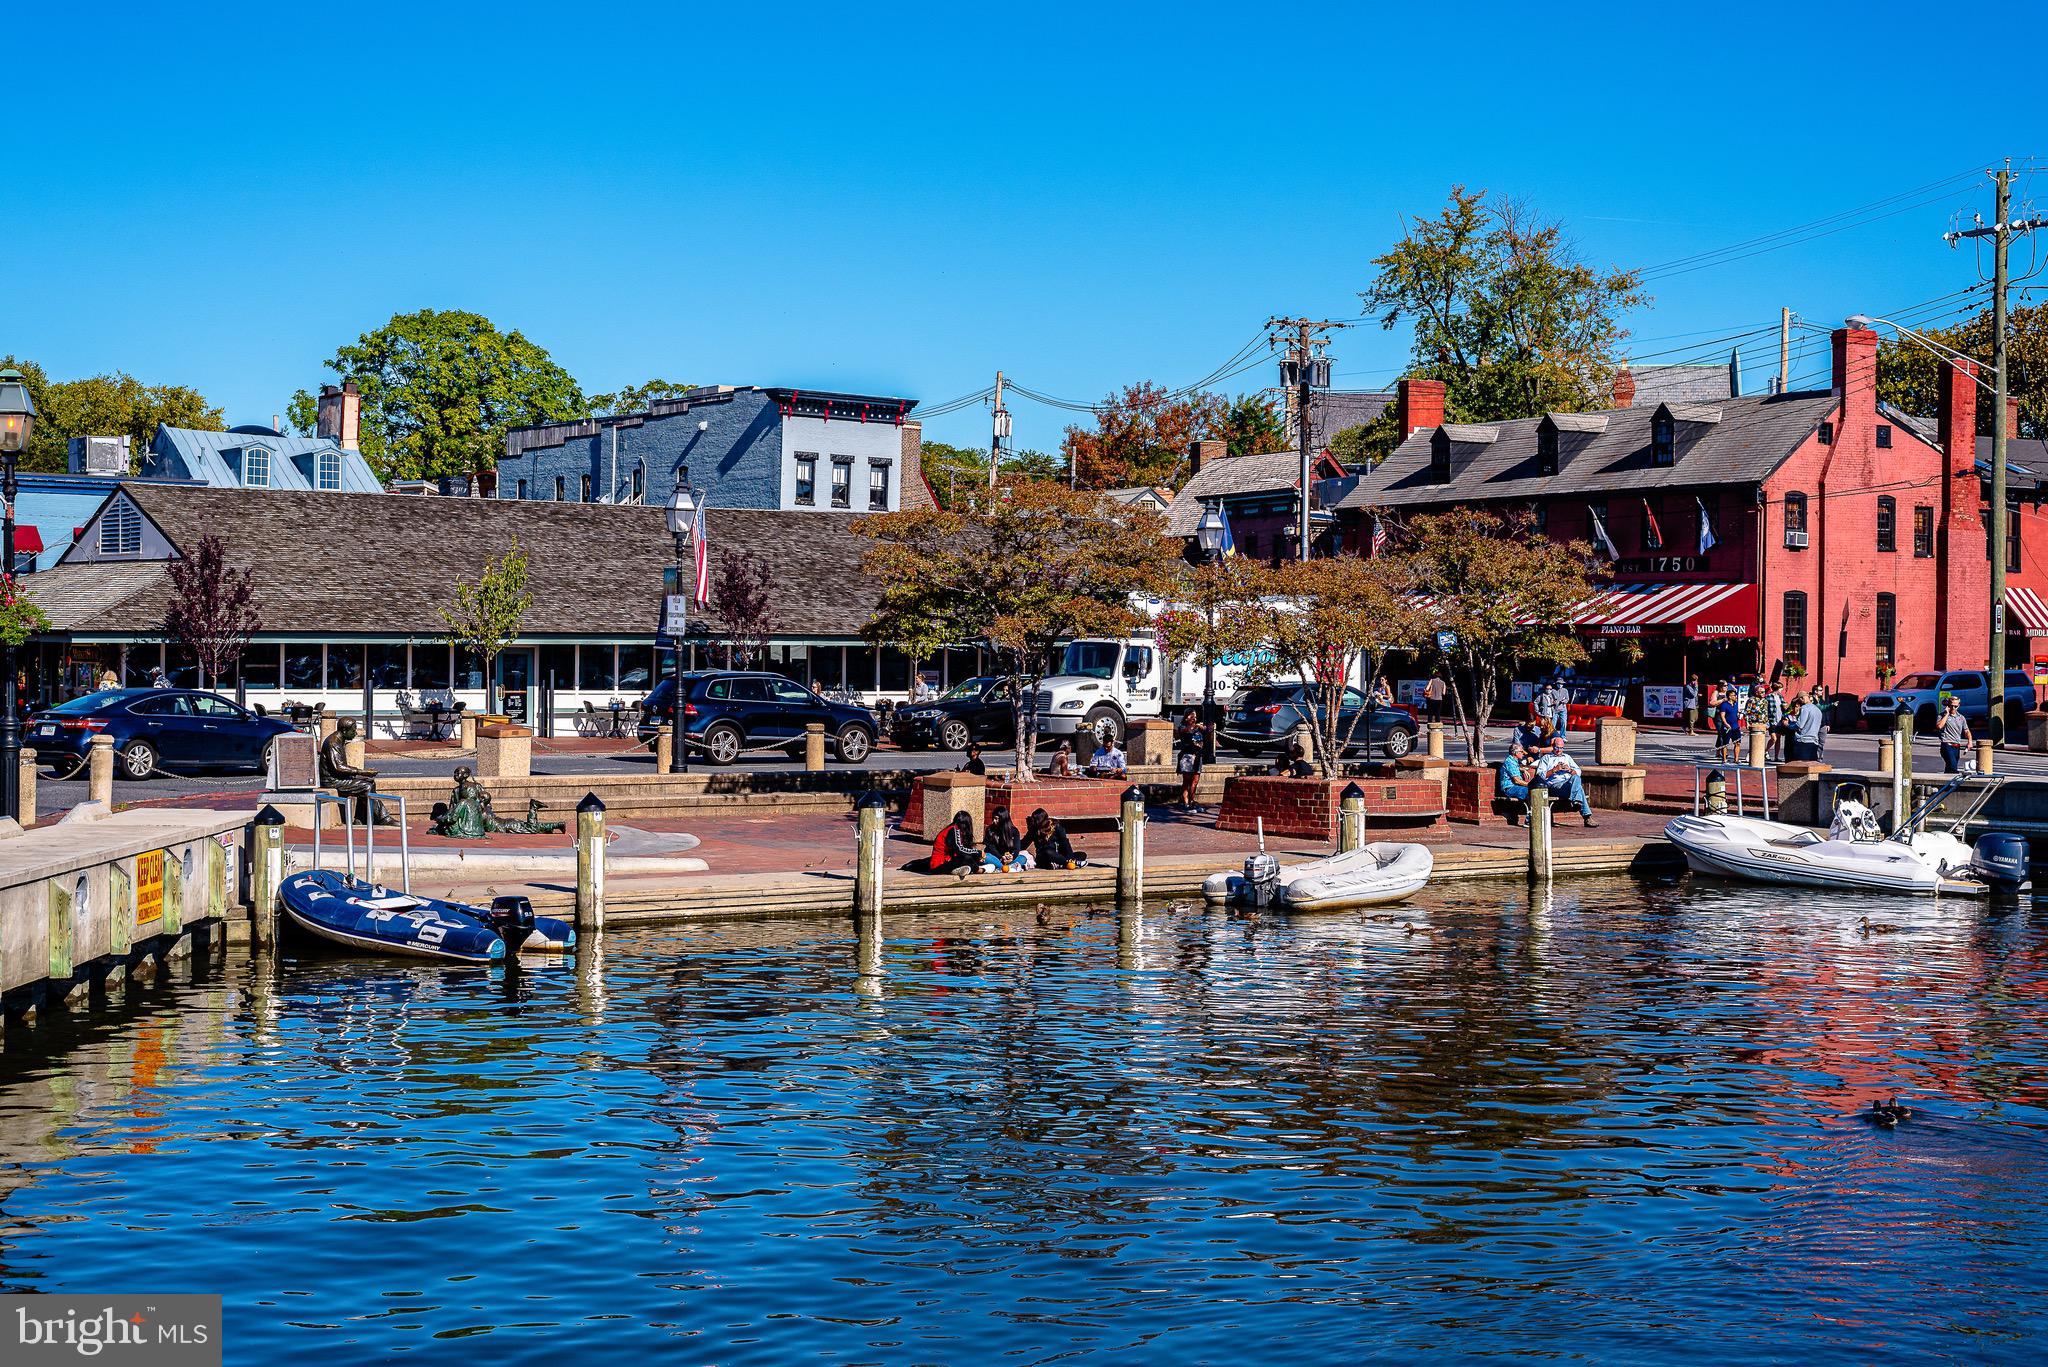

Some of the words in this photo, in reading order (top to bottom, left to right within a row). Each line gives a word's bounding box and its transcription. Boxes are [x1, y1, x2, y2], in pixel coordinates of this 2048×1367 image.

[1649, 557, 1695, 572] 1750
[1601, 626, 1625, 634] PIANO
[1626, 625, 1641, 634] BAR
[1697, 625, 1746, 634] MIDDLETON
[1999, 856, 2018, 865] YAMAHA
[137, 857, 149, 887] KEEP
[150, 853, 162, 884] CLEAR
[411, 941, 441, 951] MERCURY
